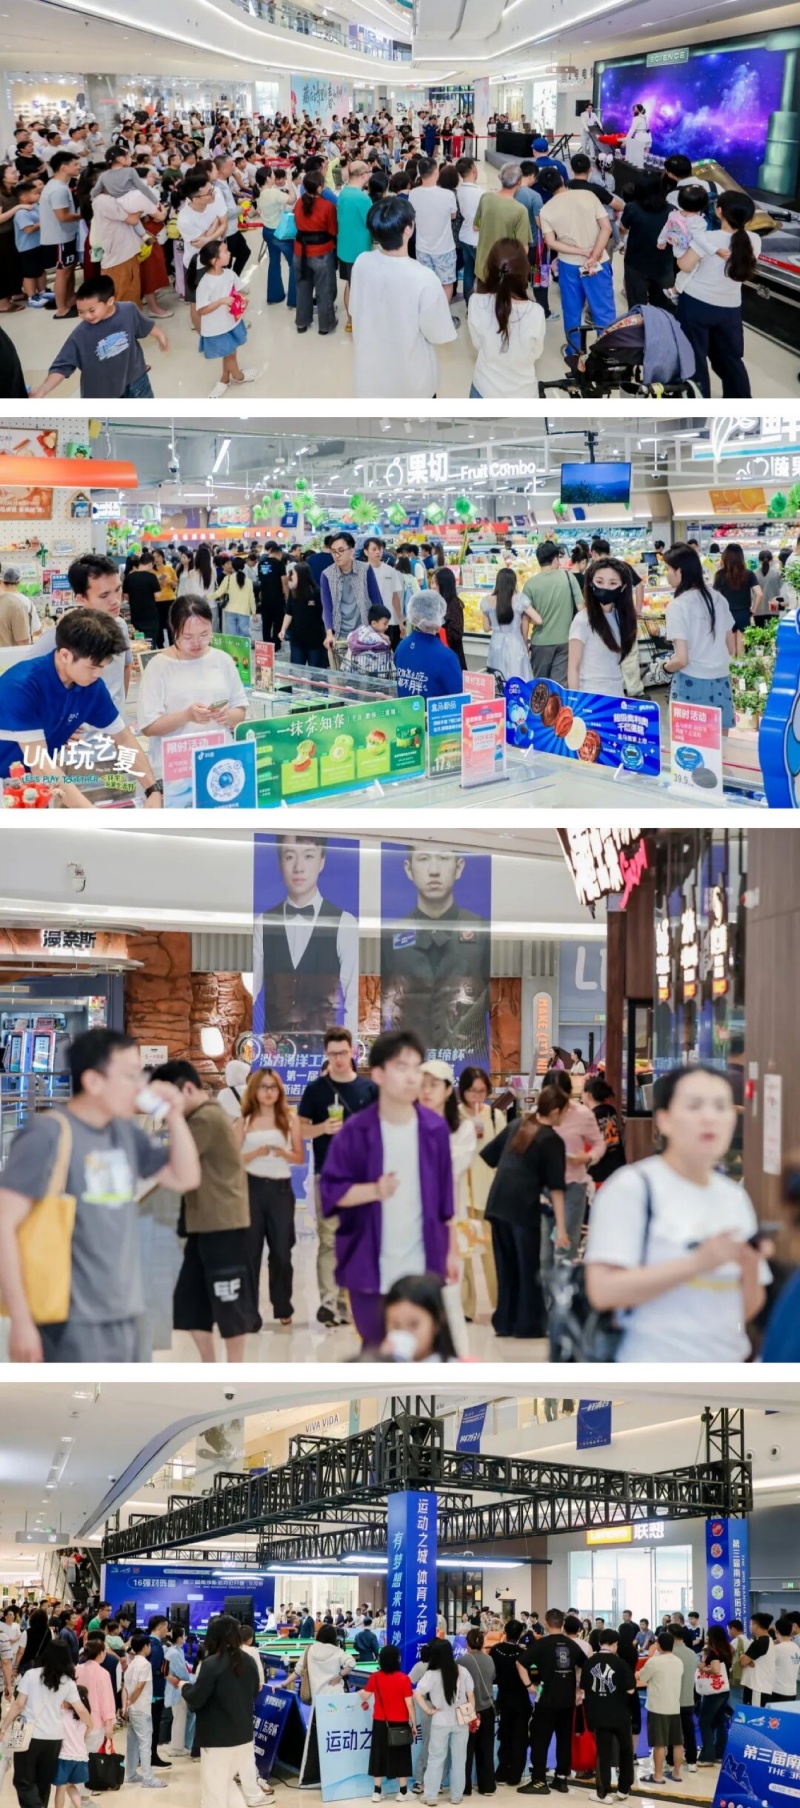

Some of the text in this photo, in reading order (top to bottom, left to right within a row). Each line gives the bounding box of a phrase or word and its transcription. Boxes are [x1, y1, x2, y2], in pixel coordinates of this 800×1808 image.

[649, 51, 686, 64] SCIENCE
[407, 452, 449, 484] 果切
[460, 459, 536, 480] Fruit Combo
[673, 707, 707, 722] 限时活动
[673, 773, 689, 786] 39.9
[537, 998, 549, 1030] MAKE
[286, 1069, 319, 1082] 第一届
[416, 1498, 429, 1564] 运动之城
[633, 1521, 665, 1540] 联想
[391, 1532, 404, 1646] 有梦想来南沙
[415, 1569, 428, 1636] 体育之城
[743, 1744, 800, 1770] 第三届南
[768, 1766, 785, 1778] THE
